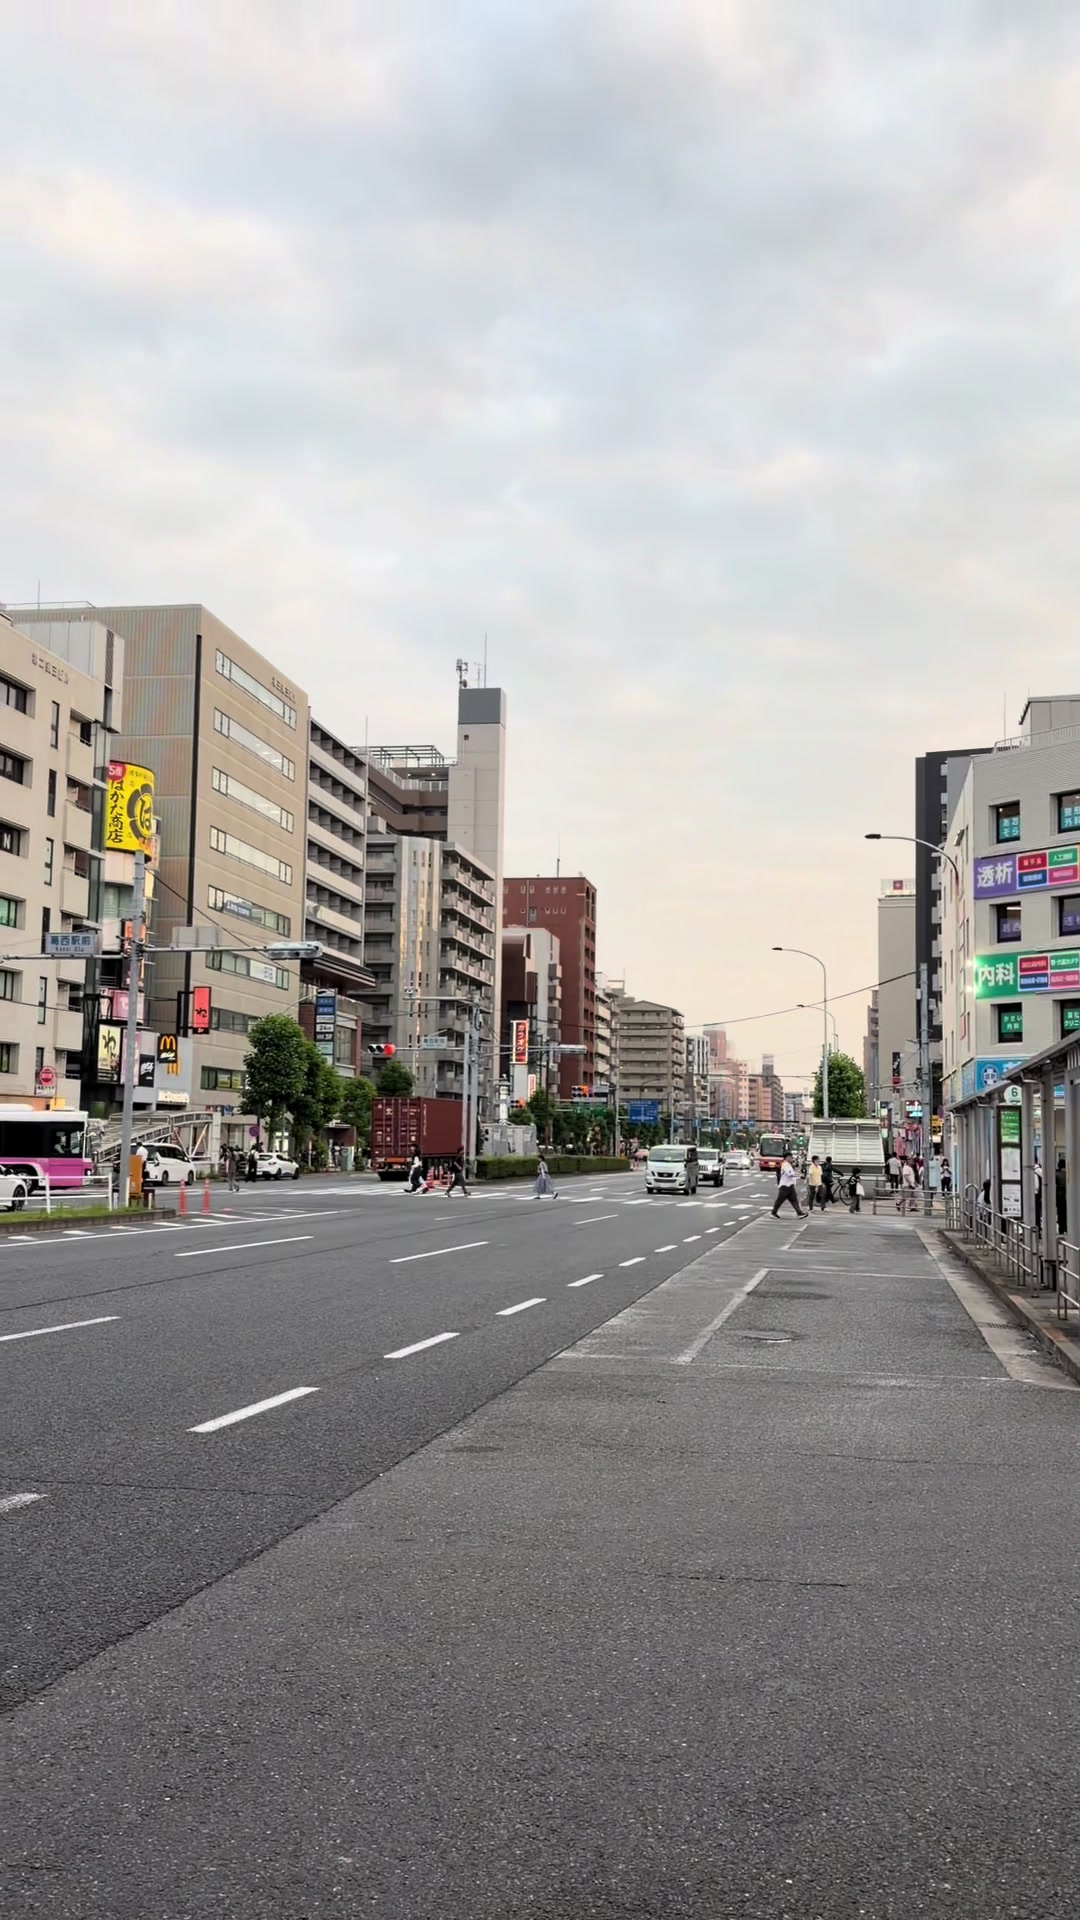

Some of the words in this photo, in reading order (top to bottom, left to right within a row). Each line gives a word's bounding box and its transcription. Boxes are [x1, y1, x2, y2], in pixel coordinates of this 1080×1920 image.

[106, 780, 124, 844] はかた商店
[977, 861, 1013, 888] 透析
[50, 935, 91, 946] 葛西駅前
[978, 961, 1015, 987] 内科
[1011, 1087, 1018, 1097] 6
